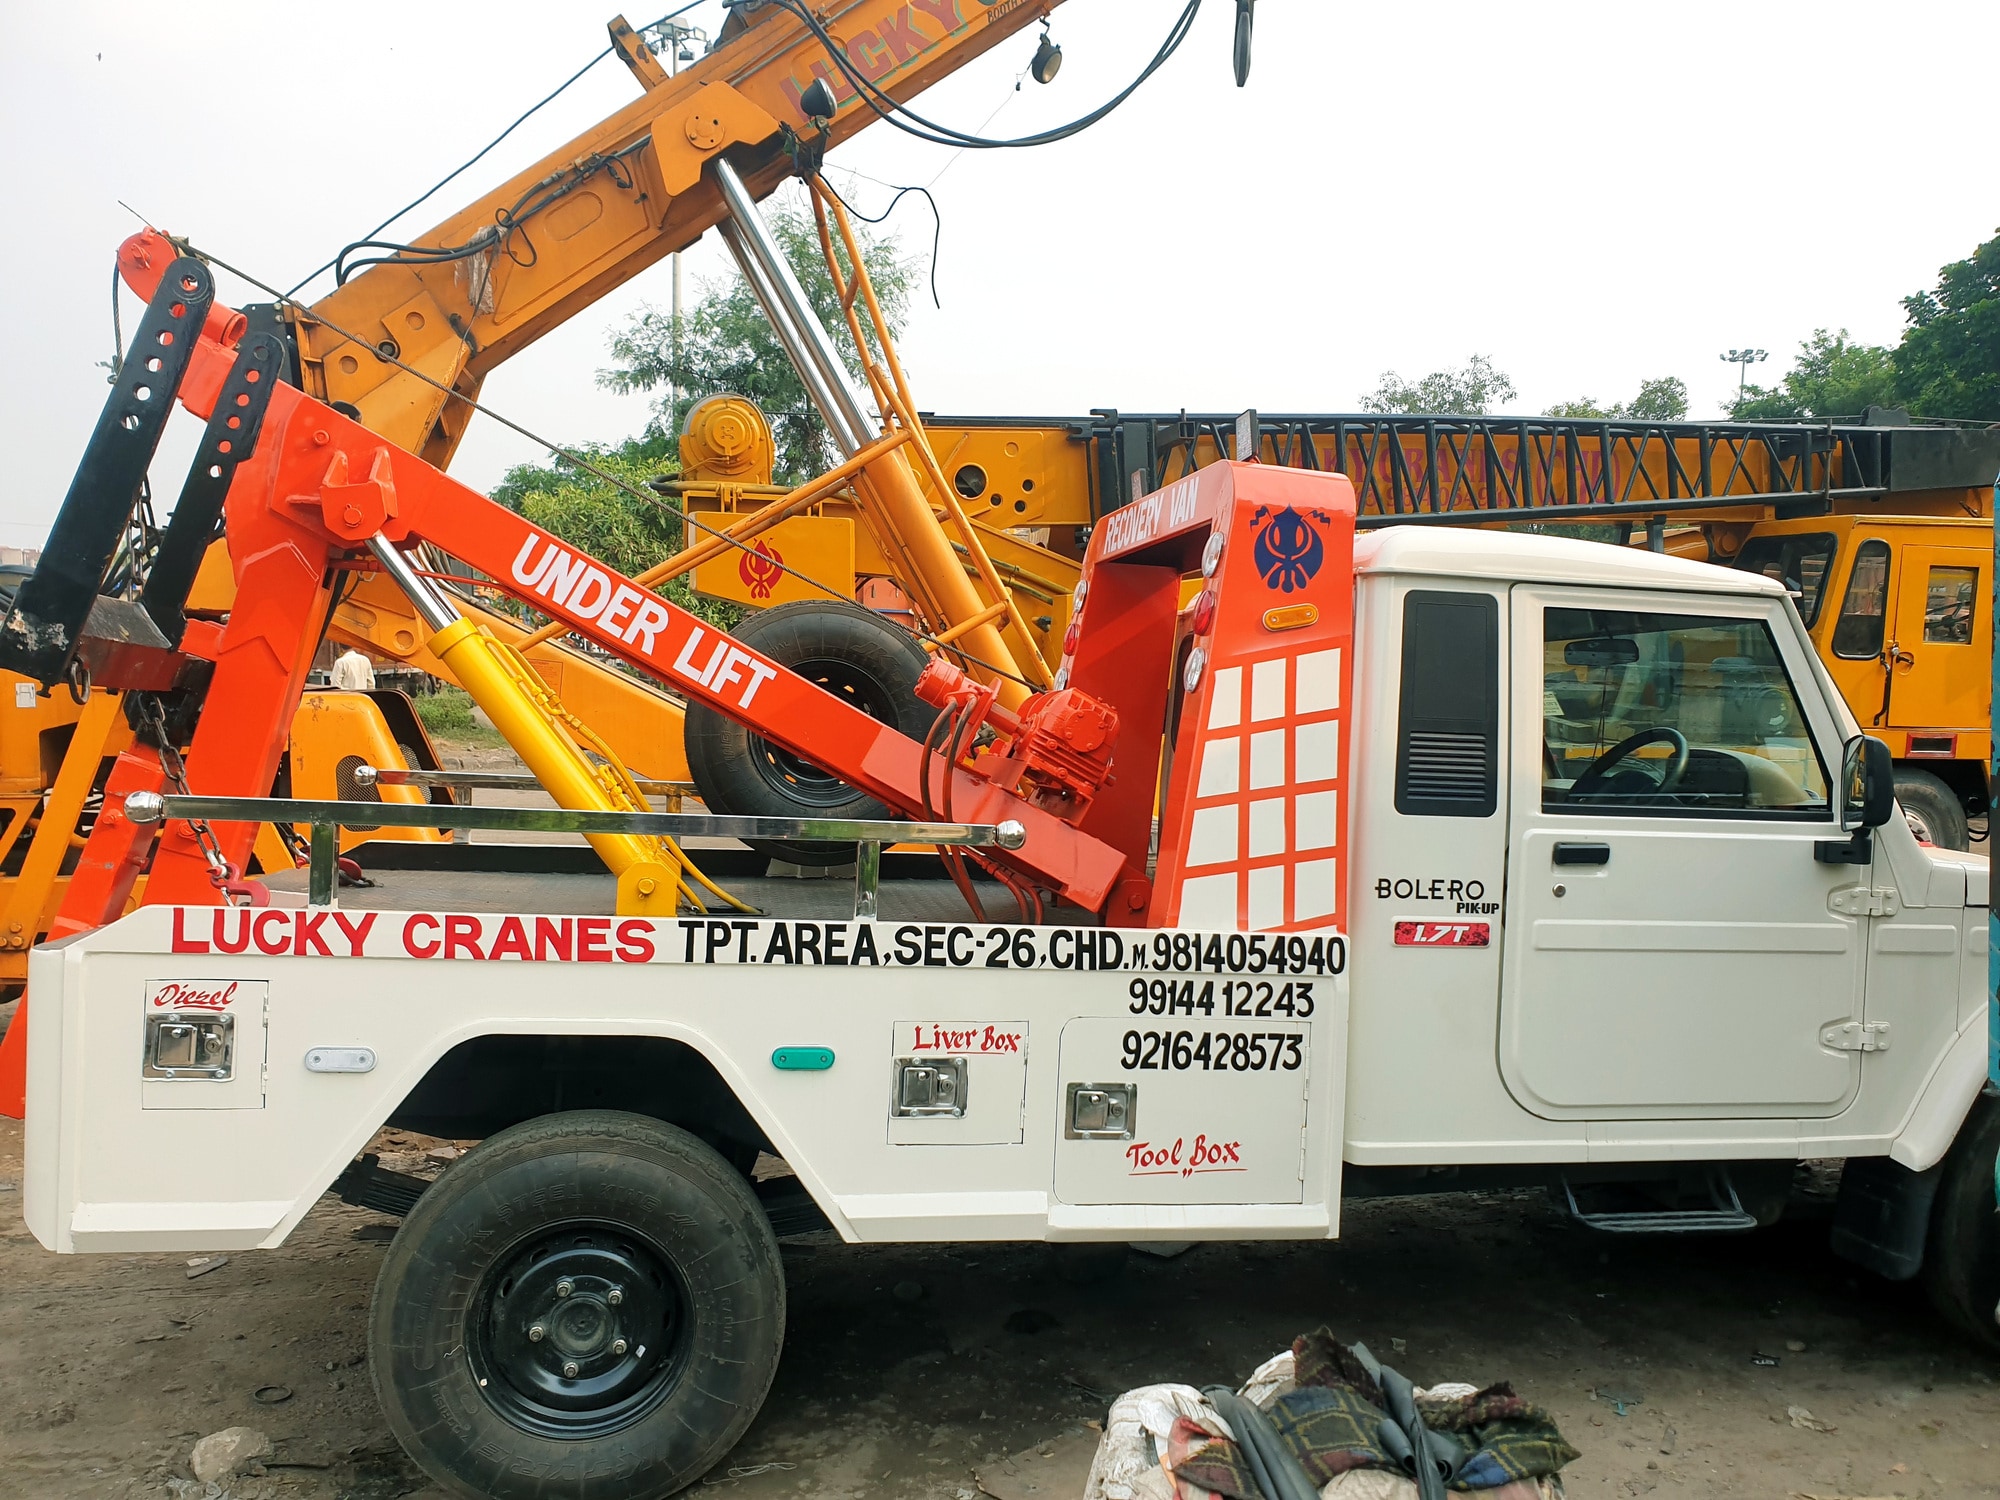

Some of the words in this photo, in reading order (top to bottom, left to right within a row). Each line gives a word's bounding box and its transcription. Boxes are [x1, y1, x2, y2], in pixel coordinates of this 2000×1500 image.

[1103, 492, 1164, 555] RECOVERY
[1169, 476, 1199, 529] VAN
[511, 532, 669, 655] UNDER
[672, 626, 777, 709] LIFT
[1375, 878, 1485, 901] BOLERO
[1456, 902, 1500, 914] PIK-UP
[171, 907, 378, 957] LUCKY
[402, 914, 656, 963] CRANES
[1151, 933, 1346, 974] 9814054940
[1413, 925, 1470, 942] 1.7T
[154, 981, 238, 1007] Diesel
[912, 1023, 978, 1051] Liver
[981, 1025, 1021, 1053] Box
[1120, 1030, 1303, 1071] 9216428573
[1126, 1137, 1183, 1171] Tool
[1190, 1134, 1242, 1166] Box
